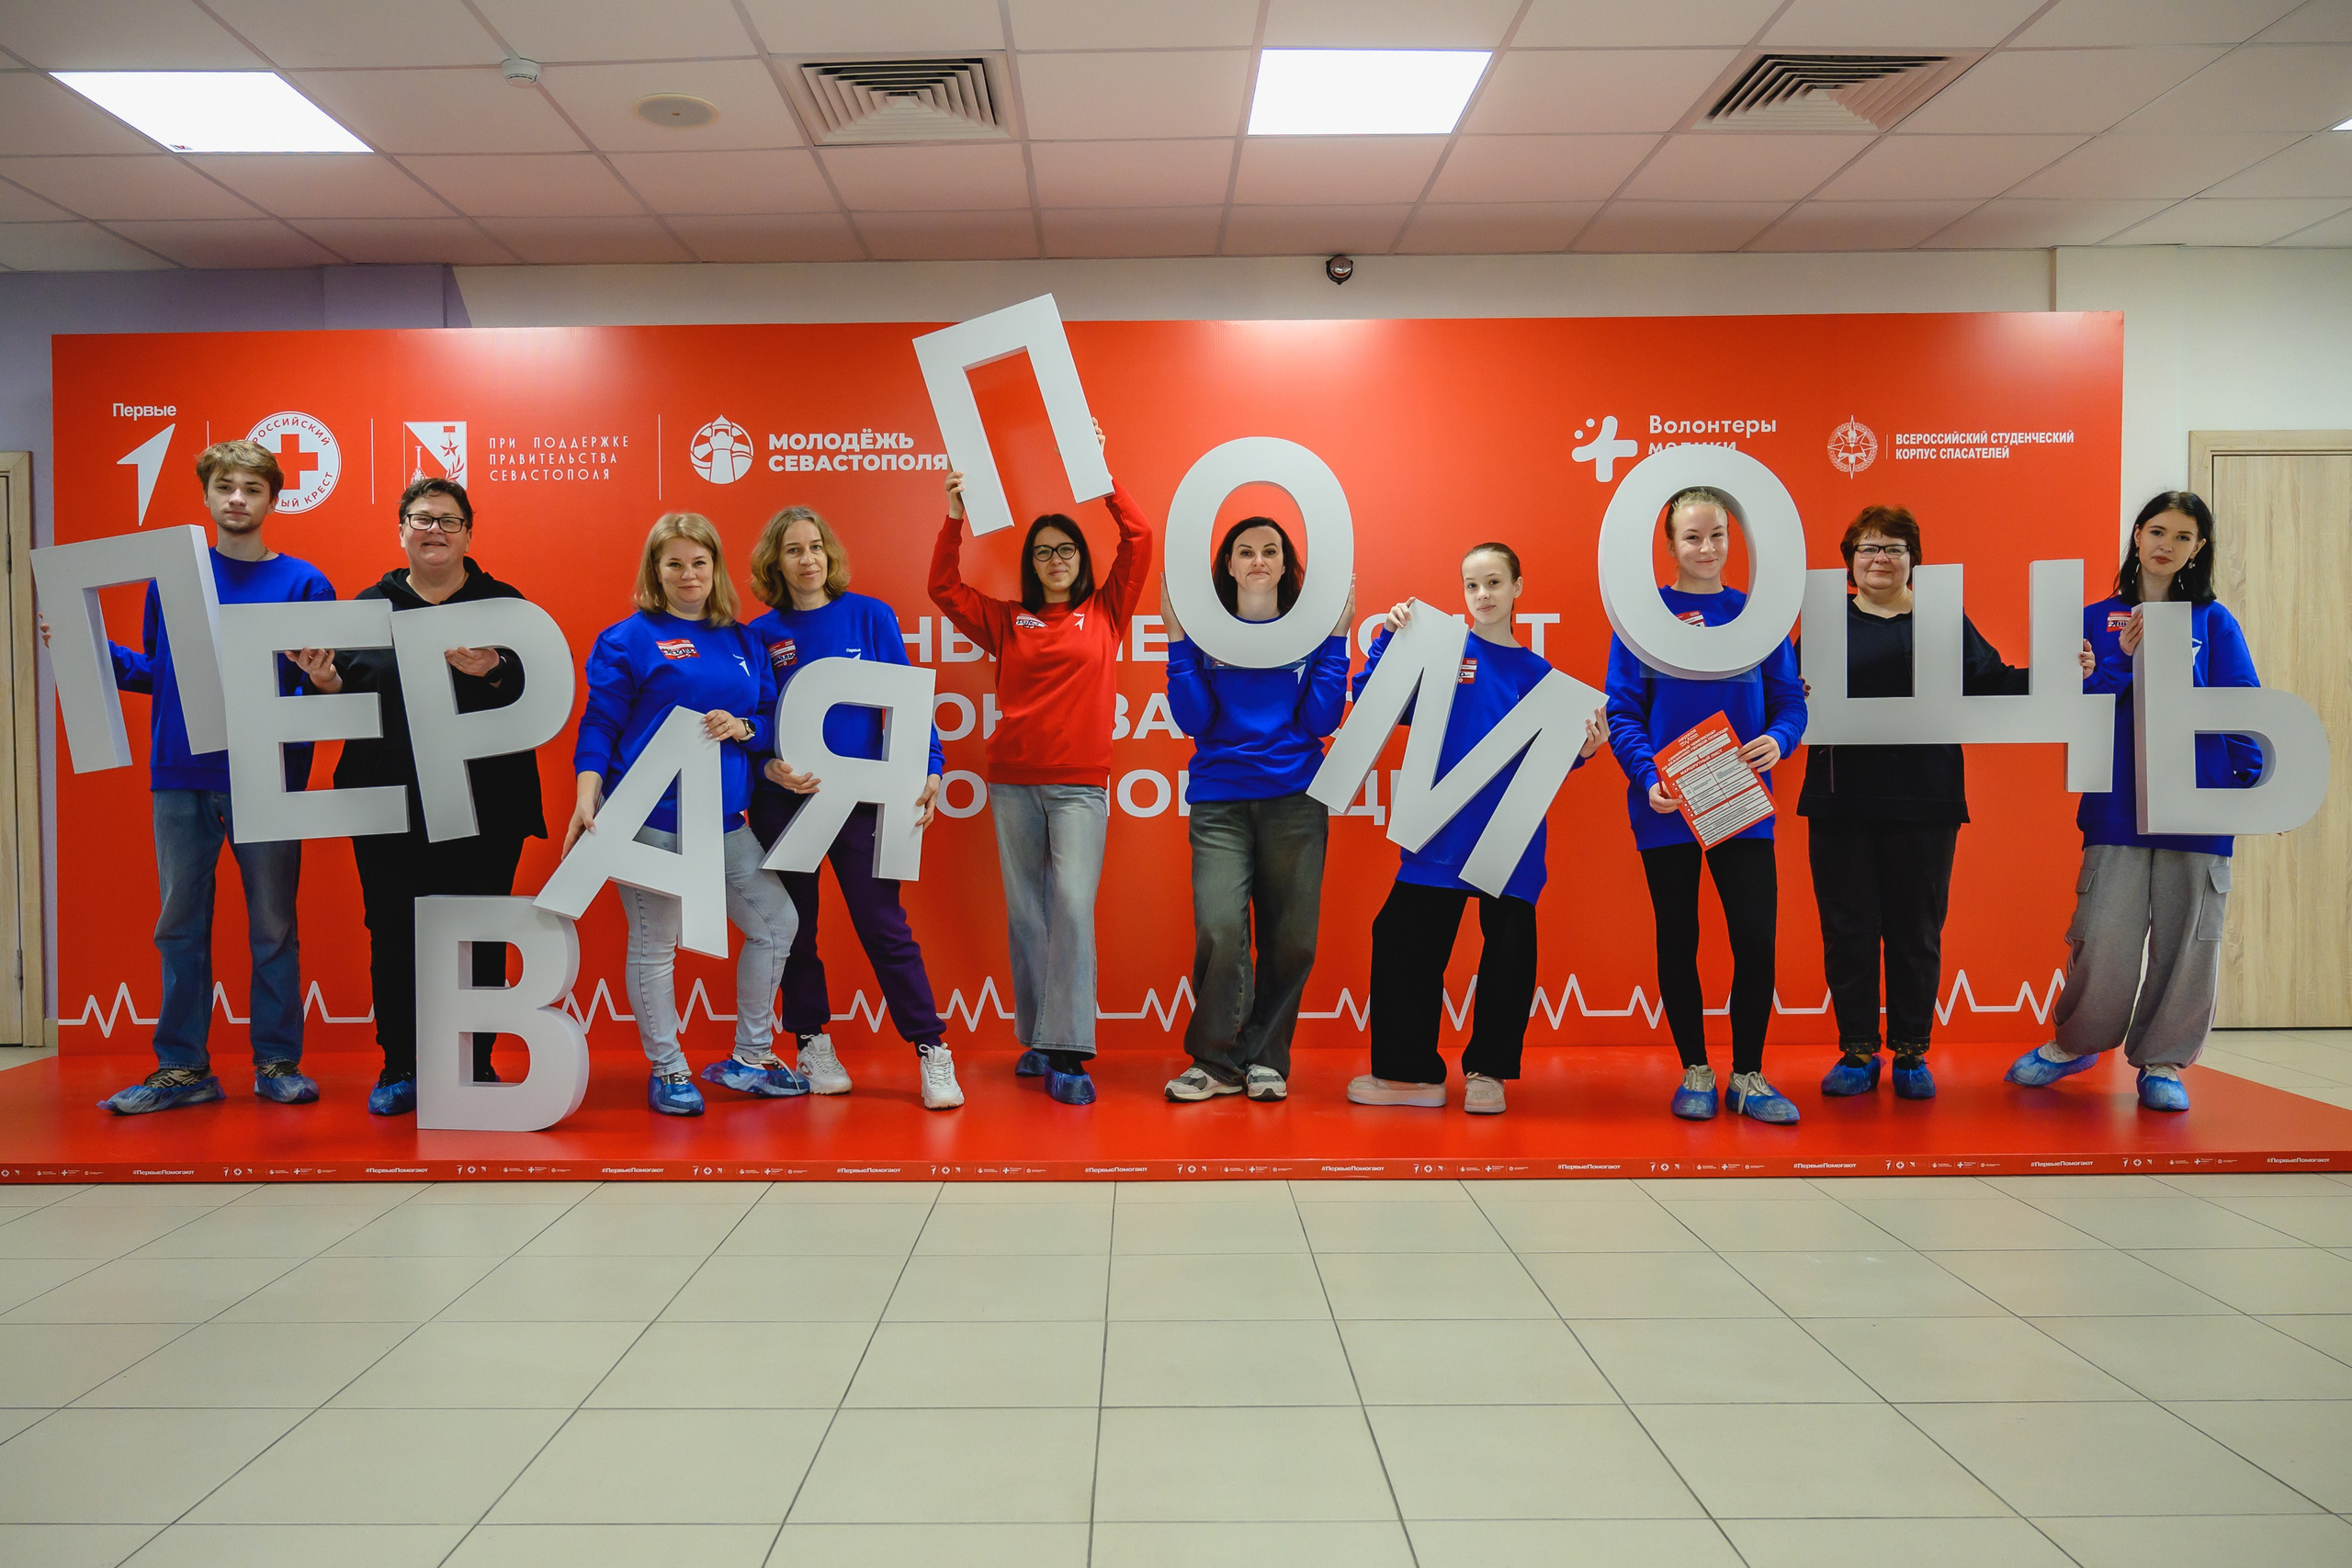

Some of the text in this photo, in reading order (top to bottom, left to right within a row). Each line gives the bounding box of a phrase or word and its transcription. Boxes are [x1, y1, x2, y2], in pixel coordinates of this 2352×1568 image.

[112, 402, 177, 421] Первые
[253, 417, 331, 446] РОССИЙСКИЙ
[1649, 415, 1777, 438] Волонтеры
[489, 435, 629, 449] ПРИ ПОДДЕРЖКЕ
[768, 428, 914, 453] МОЛОДЁЖЬ
[1895, 429, 2075, 446] ВСЕРОССИЙСКИЙ СТУДЕНЧЕСКИЙ
[489, 453, 617, 466] ПРАВИТЕЛЬСТВА
[1895, 445, 2010, 460] КОРПУС СПАСАТЕЛЕЙ
[768, 454, 948, 472] СЕВАСТОПОЛЯ
[490, 468, 610, 481] СЕВАСТОПОЛЯ
[304, 471, 334, 505] КРЕСТ
